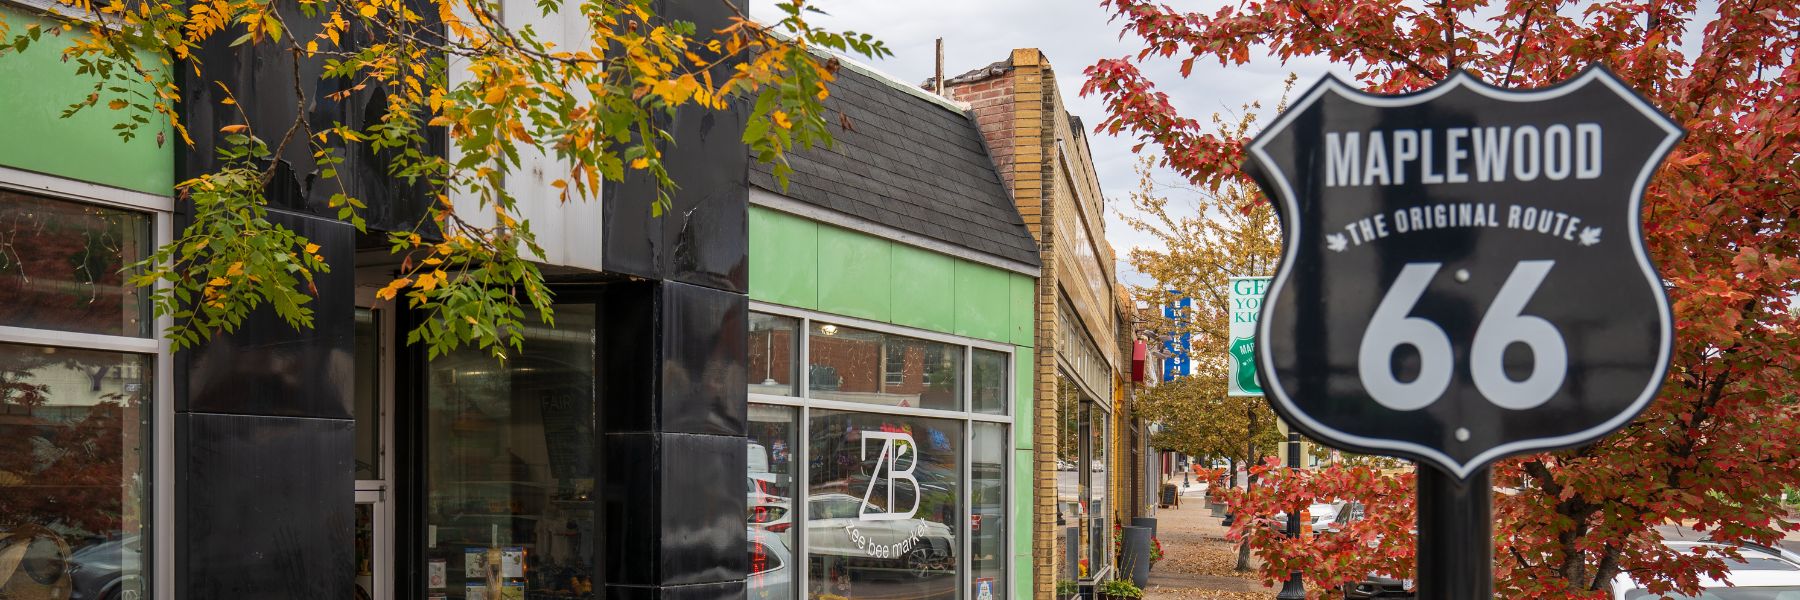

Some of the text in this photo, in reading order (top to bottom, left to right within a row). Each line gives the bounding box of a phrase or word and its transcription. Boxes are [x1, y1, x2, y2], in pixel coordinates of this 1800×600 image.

[1325, 122, 1603, 188] MAPLEWOOD
[1345, 202, 1581, 246] THE ORIGINAL ROUTE
[1234, 279, 1271, 296] GE
[1357, 259, 1568, 411] 66
[868, 537, 889, 559] bee
[892, 517, 929, 558] market
